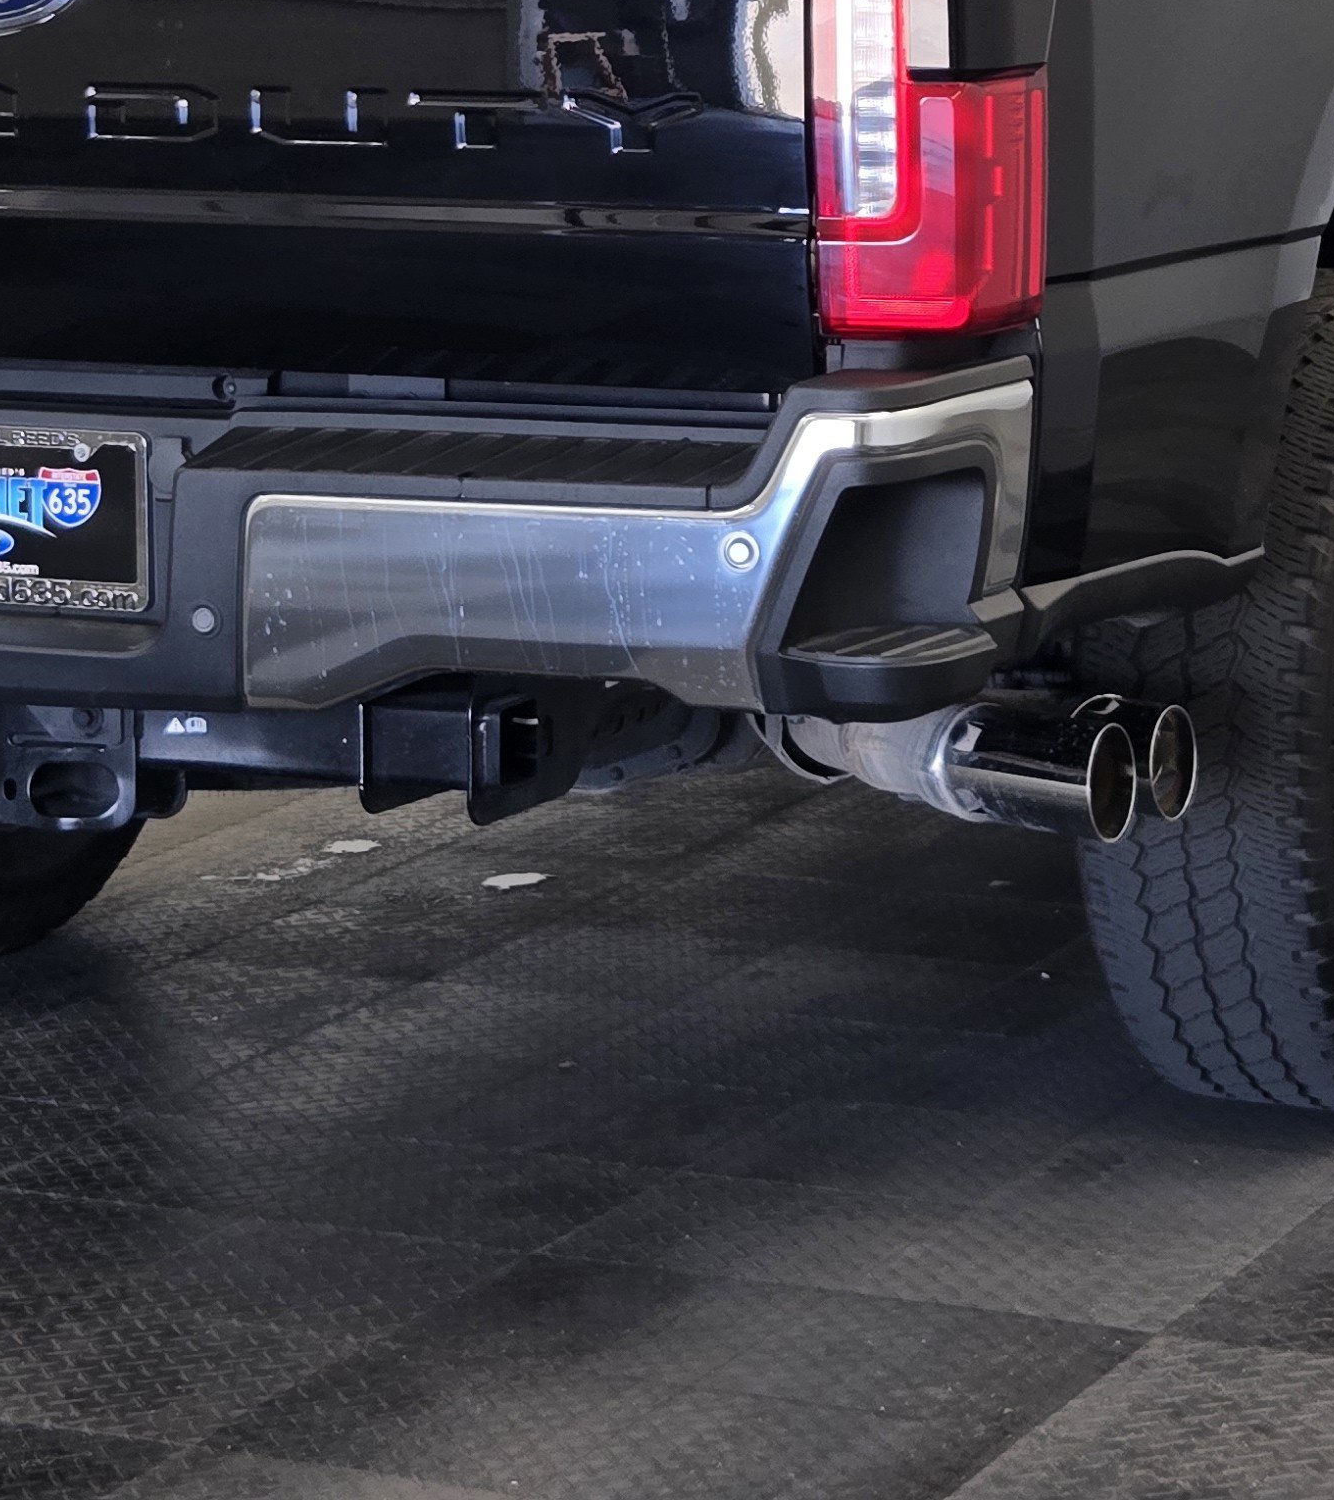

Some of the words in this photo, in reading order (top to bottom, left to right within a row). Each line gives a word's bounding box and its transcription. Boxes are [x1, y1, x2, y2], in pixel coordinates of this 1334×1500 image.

[83, 81, 702, 155] DUTY
[12, 429, 81, 447] REED'S
[49, 488, 91, 516] 635
